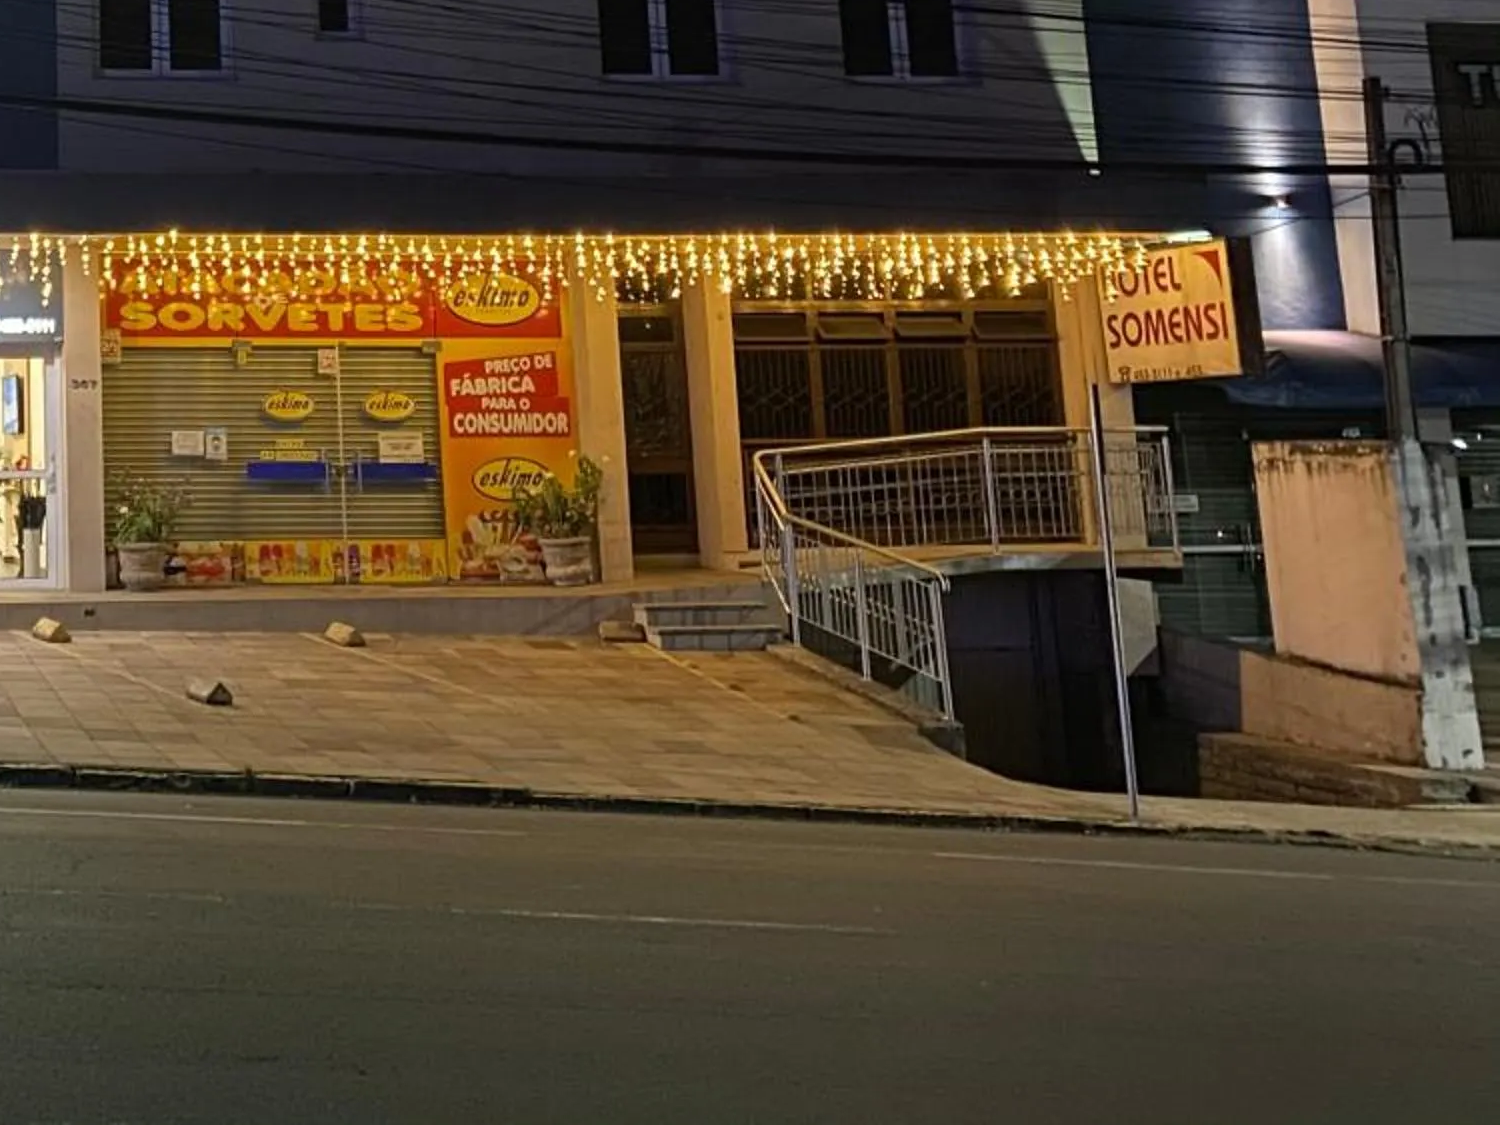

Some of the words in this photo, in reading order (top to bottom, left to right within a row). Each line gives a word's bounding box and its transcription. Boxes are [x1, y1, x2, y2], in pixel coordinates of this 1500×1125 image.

[119, 302, 424, 332] SORVETES
[1106, 302, 1230, 349] SOMENSI
[484, 357, 531, 374] PREÇO
[533, 353, 553, 369] DE
[450, 373, 536, 396] FÁBRICA
[267, 390, 310, 411] eskimo
[368, 390, 410, 412] eskimo
[481, 397, 516, 410] PARA
[519, 397, 531, 411] O
[453, 412, 569, 434] CONSUMIDOR
[479, 459, 543, 487] eskimo
